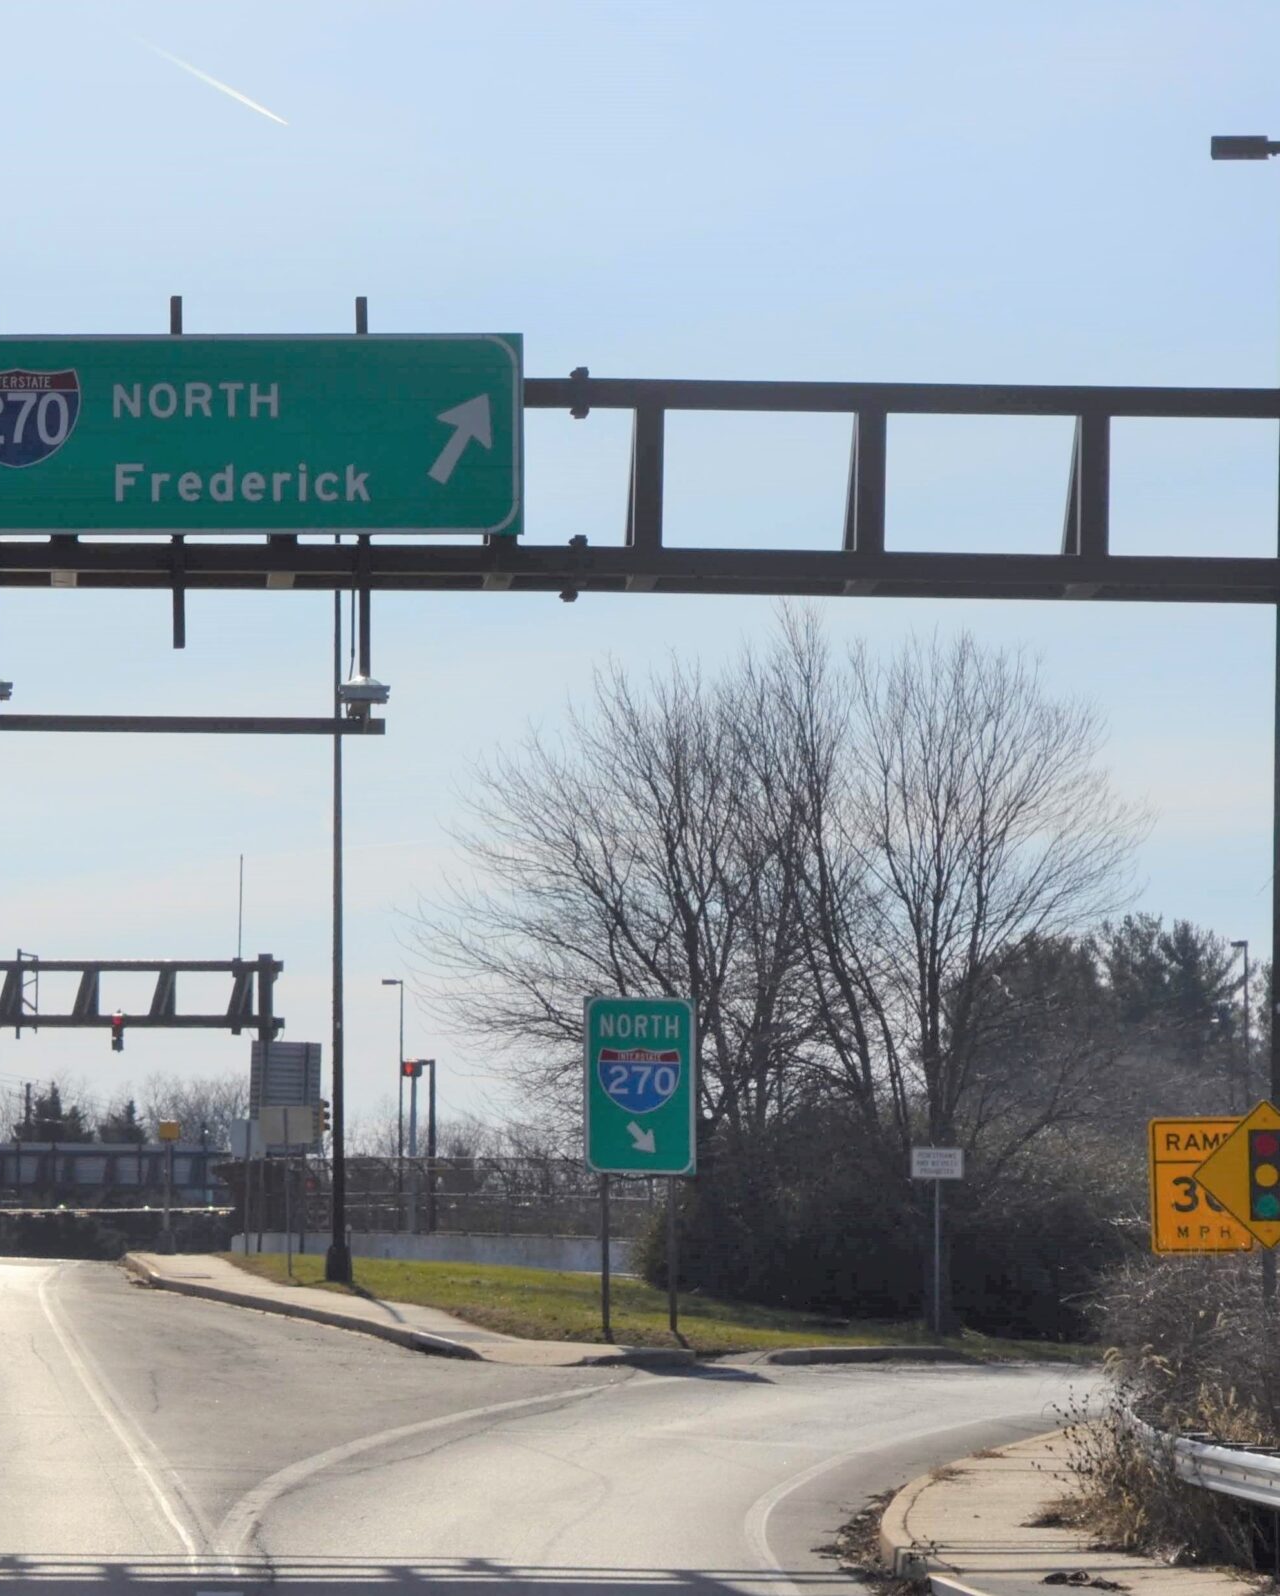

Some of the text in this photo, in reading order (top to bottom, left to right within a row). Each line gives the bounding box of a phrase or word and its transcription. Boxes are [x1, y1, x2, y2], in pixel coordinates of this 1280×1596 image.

[112, 382, 279, 418] NORTH
[114, 463, 371, 502] Frederick
[599, 1014, 680, 1038] NORTH
[608, 1065, 676, 1096] 270
[1165, 1133, 1228, 1152] RAM
